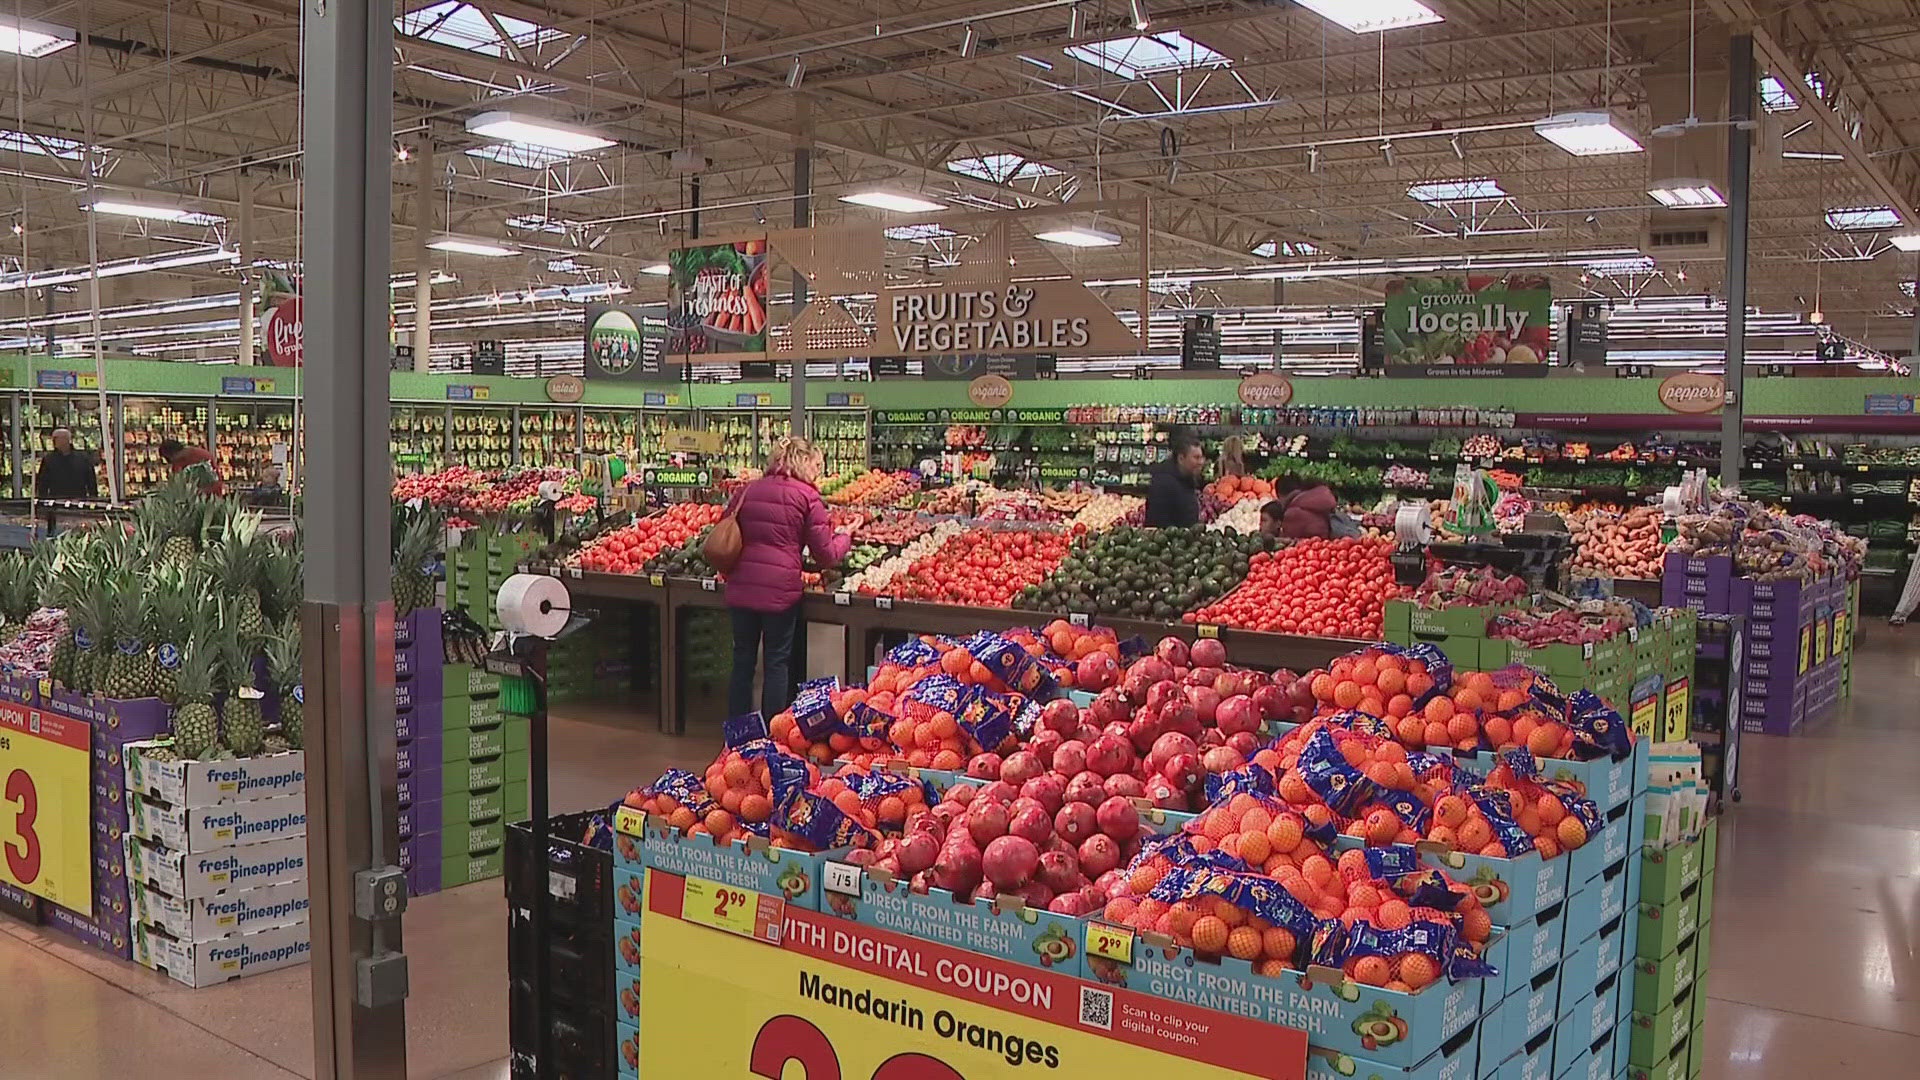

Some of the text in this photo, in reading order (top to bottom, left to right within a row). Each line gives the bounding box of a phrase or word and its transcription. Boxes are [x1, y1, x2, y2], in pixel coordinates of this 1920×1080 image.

[692, 273, 742, 292] A TASTE OF
[681, 288, 748, 317] Freshness
[891, 284, 1034, 322] FRUITS &
[1421, 293, 1476, 309] grown
[1407, 304, 1529, 340] locally
[1588, 307, 1595, 318] 5
[275, 317, 303, 355] fre
[892, 318, 1089, 351] VEGETABLES
[481, 342, 492, 350] 14
[1824, 346, 1835, 359] 4
[1427, 368, 1450, 376] Grown
[1459, 368, 1471, 376] the
[1472, 368, 1504, 376] Midwest.
[551, 382, 579, 394] salads
[971, 384, 1008, 400] organic
[1244, 384, 1284, 400] veggies
[1663, 382, 1723, 400] peppers
[887, 411, 925, 422] ORGANIC
[951, 411, 990, 421] ORGANIC
[1019, 411, 1061, 421] ORGANIC
[657, 472, 696, 483] ORGANIC
[1041, 468, 1078, 477] ORGANIC
[0, 709, 24, 727] UPON
[207, 767, 248, 783] fresh
[237, 770, 305, 794] pineapple
[4, 768, 41, 885] 3
[203, 811, 243, 830] fresh
[234, 813, 306, 840] pineapples
[199, 855, 239, 873] fresh
[644, 838, 772, 877] DIRECT FROM THE FARM.
[230, 857, 304, 883] pineapples
[654, 855, 722, 881] GUARANTEED
[725, 870, 762, 890] FRESH.
[206, 898, 247, 916] fresh
[237, 899, 309, 926] pineapples
[863, 891, 1027, 940] DIRECT FROM THE FARM.
[875, 909, 1014, 955] GUARANTEED FRESH.
[209, 943, 250, 962] fresh
[240, 940, 311, 970] pineapples
[833, 932, 928, 977] DIGITAL
[935, 958, 1052, 1010] COUPON
[1135, 957, 1345, 1019] DIRECT FROM THE FARM.
[1150, 981, 1328, 1034] GUARANTEED FRESH.
[799, 971, 924, 1031] Mandarin
[933, 1010, 1060, 1069] Oranges
[1121, 1003, 1210, 1035] Scan to clip your
[1121, 1018, 1200, 1047] digital coupon.
